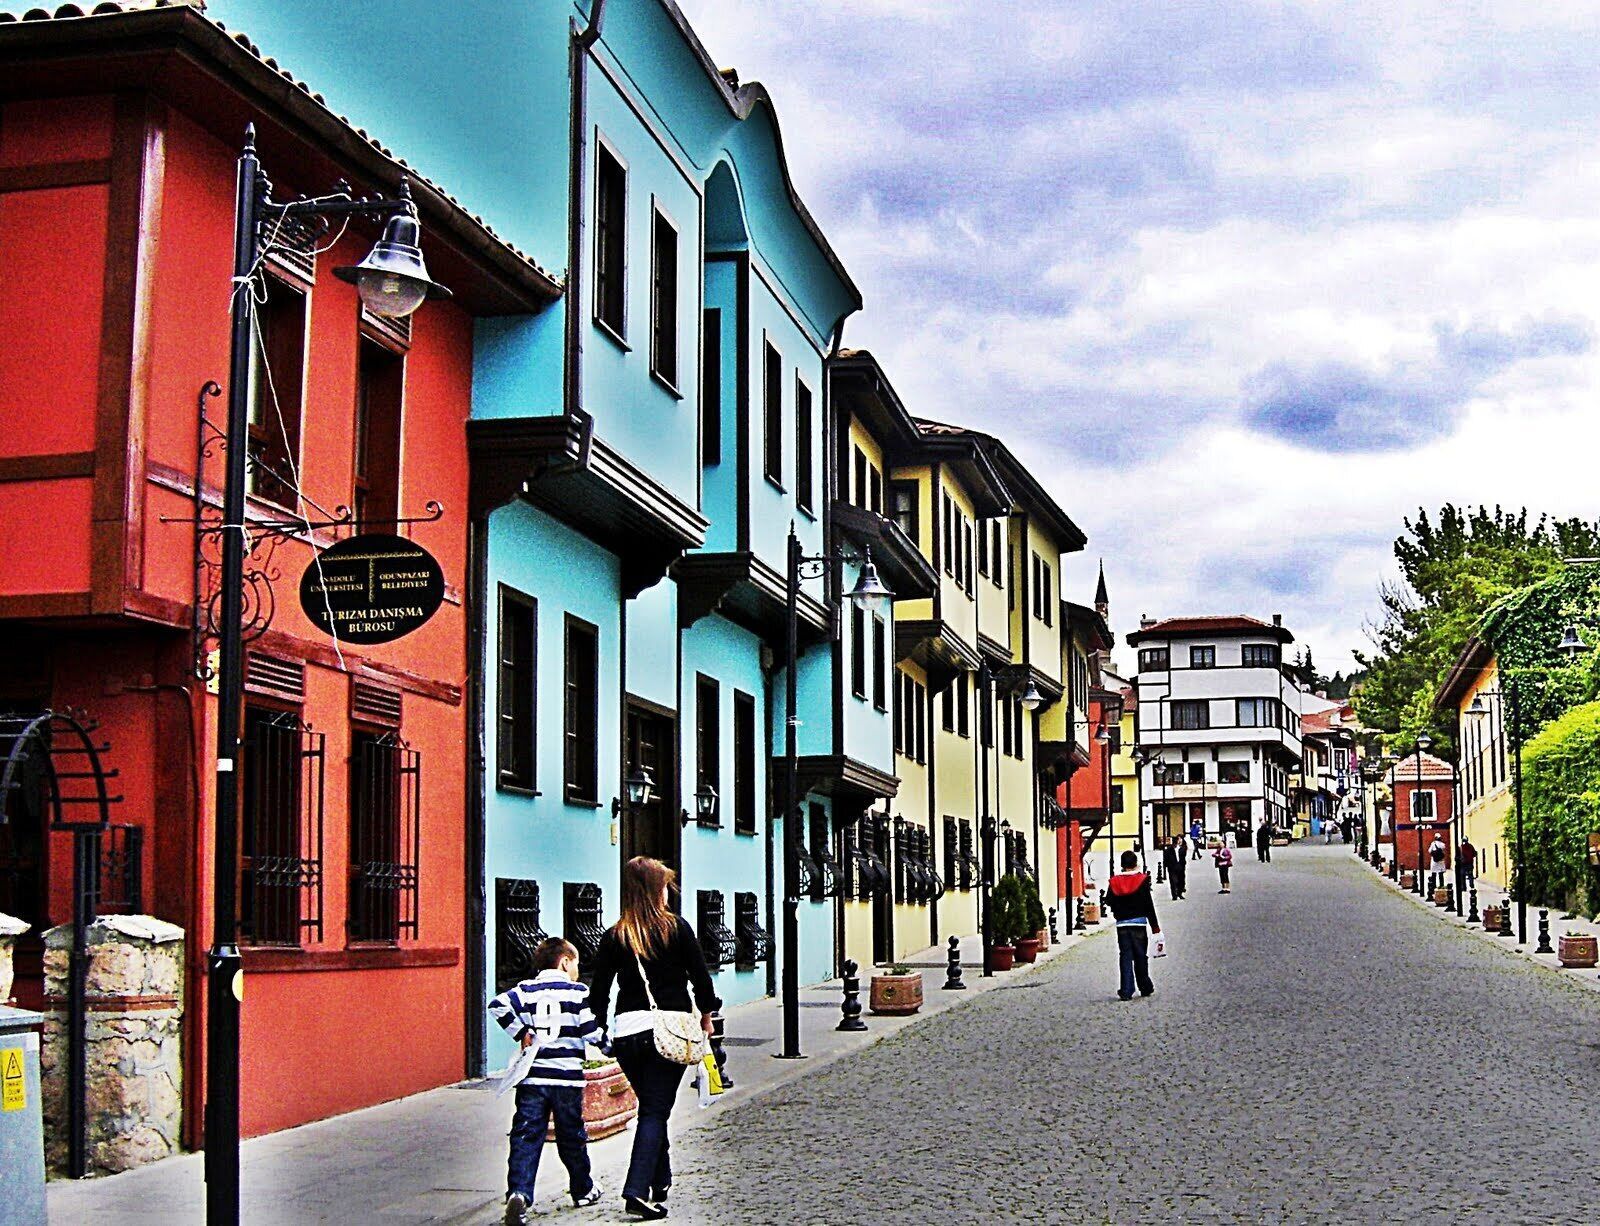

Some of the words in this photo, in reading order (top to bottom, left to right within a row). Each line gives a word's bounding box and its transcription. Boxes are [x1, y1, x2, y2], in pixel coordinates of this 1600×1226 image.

[319, 575, 357, 583] NADOLU
[369, 606, 424, 620] DANIŞMA
[536, 998, 562, 1043] 9
